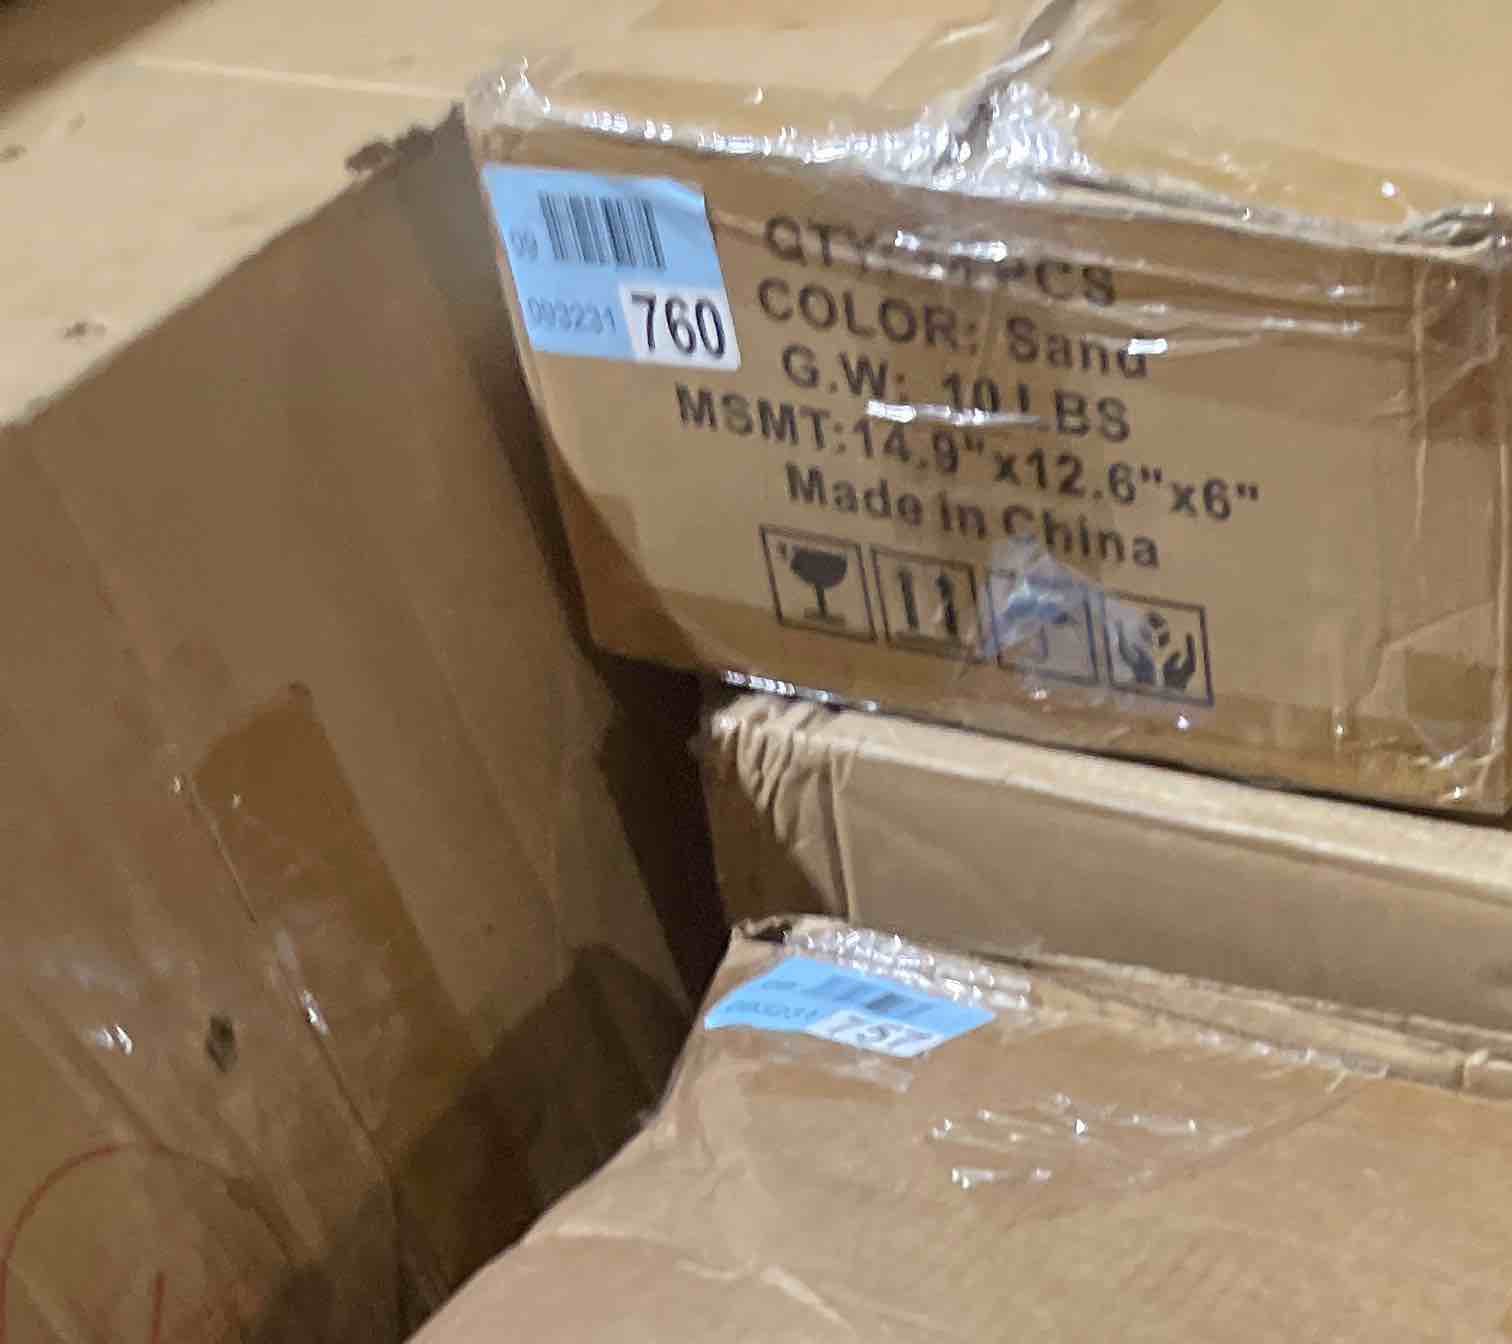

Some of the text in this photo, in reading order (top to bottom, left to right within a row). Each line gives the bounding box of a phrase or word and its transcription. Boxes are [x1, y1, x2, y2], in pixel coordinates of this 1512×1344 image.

[631, 291, 726, 358] 760
[757, 277, 980, 356] COLOR:
[784, 461, 924, 526] Made
[1002, 505, 1160, 569] China
